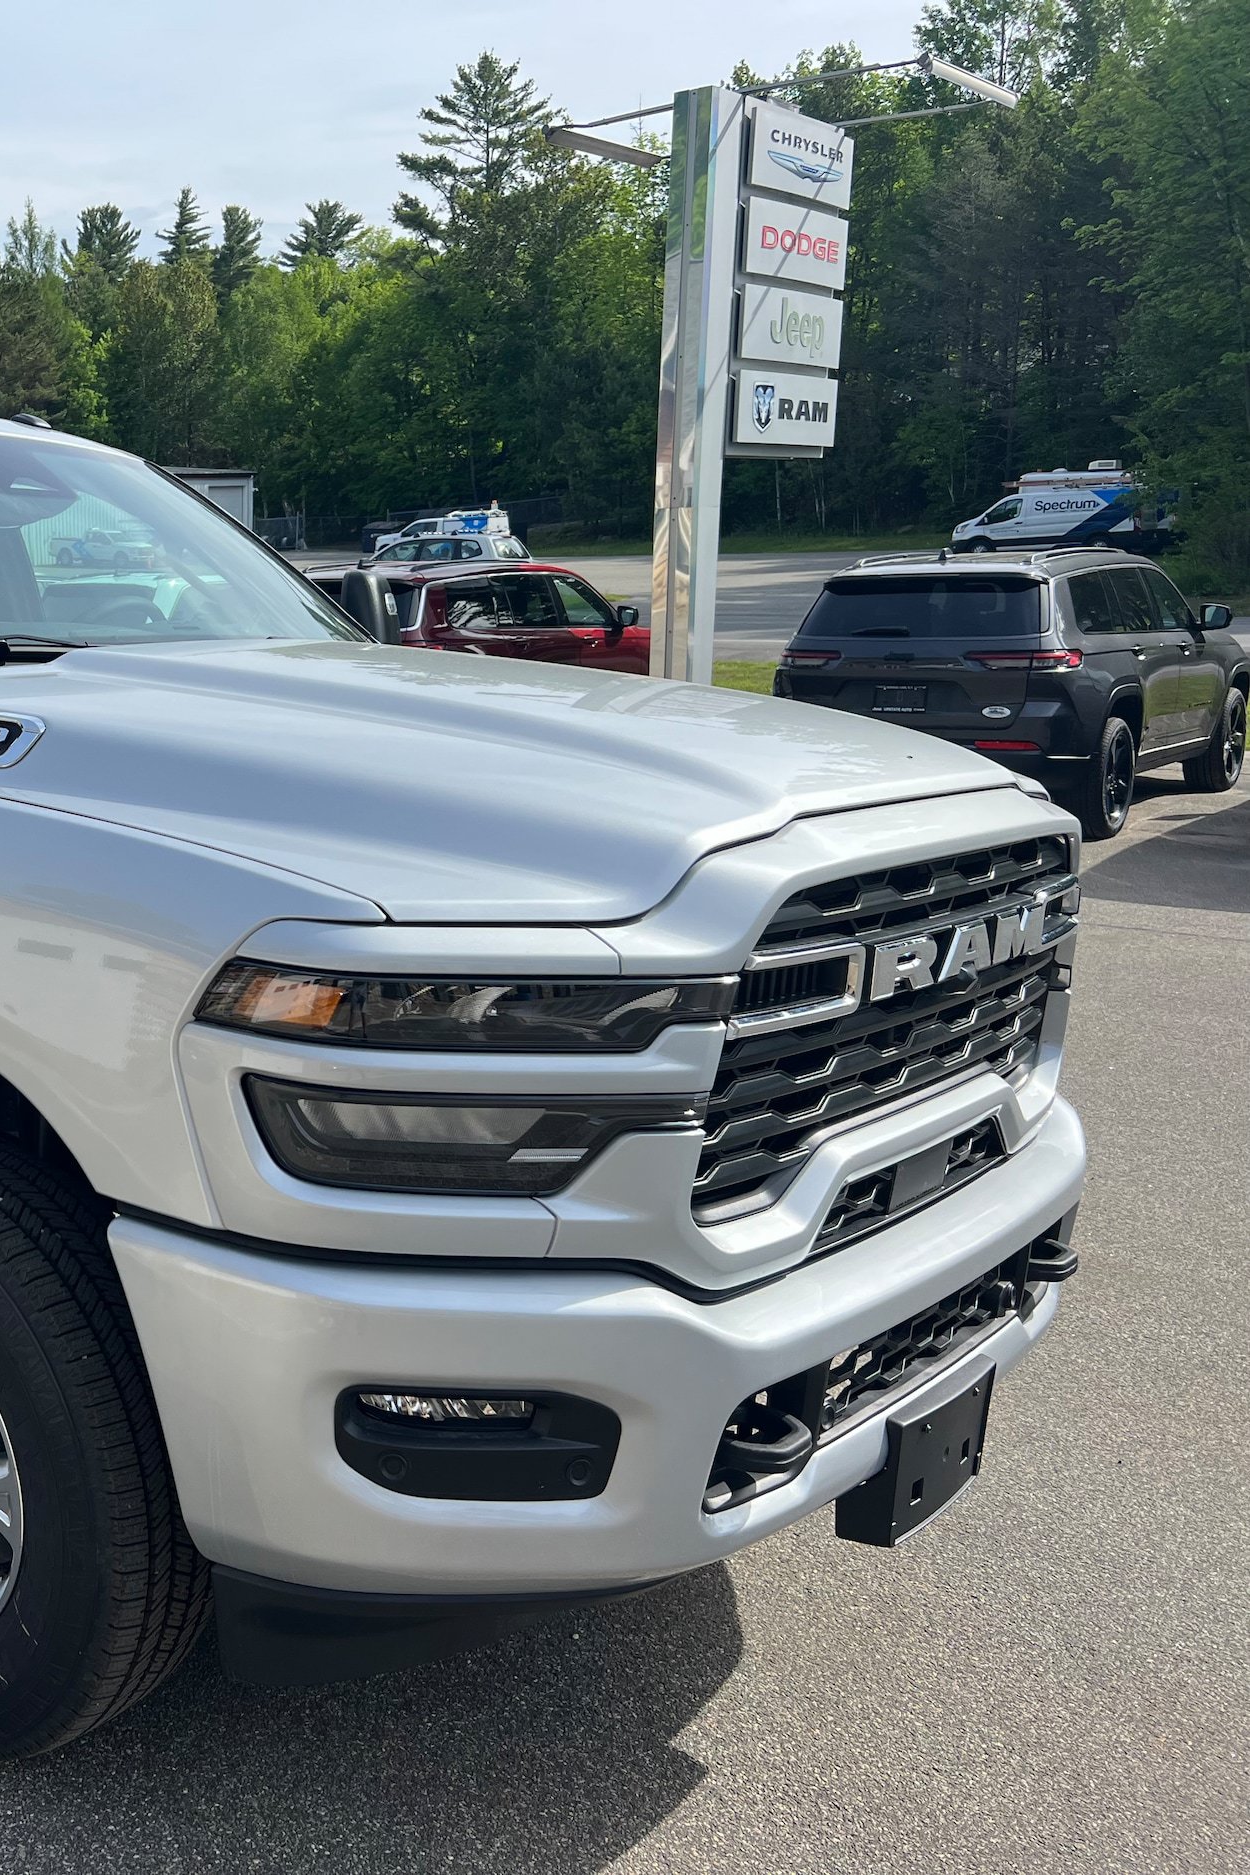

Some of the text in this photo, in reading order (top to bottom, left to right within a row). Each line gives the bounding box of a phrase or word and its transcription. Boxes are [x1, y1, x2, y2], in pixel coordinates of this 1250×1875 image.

[771, 129, 844, 163] CHRYSLER
[761, 225, 839, 264] DODGE
[770, 296, 825, 358] Jeep
[778, 398, 829, 423] RAM
[1034, 499, 1096, 513] Spectrum
[870, 901, 1048, 1002] RAM
